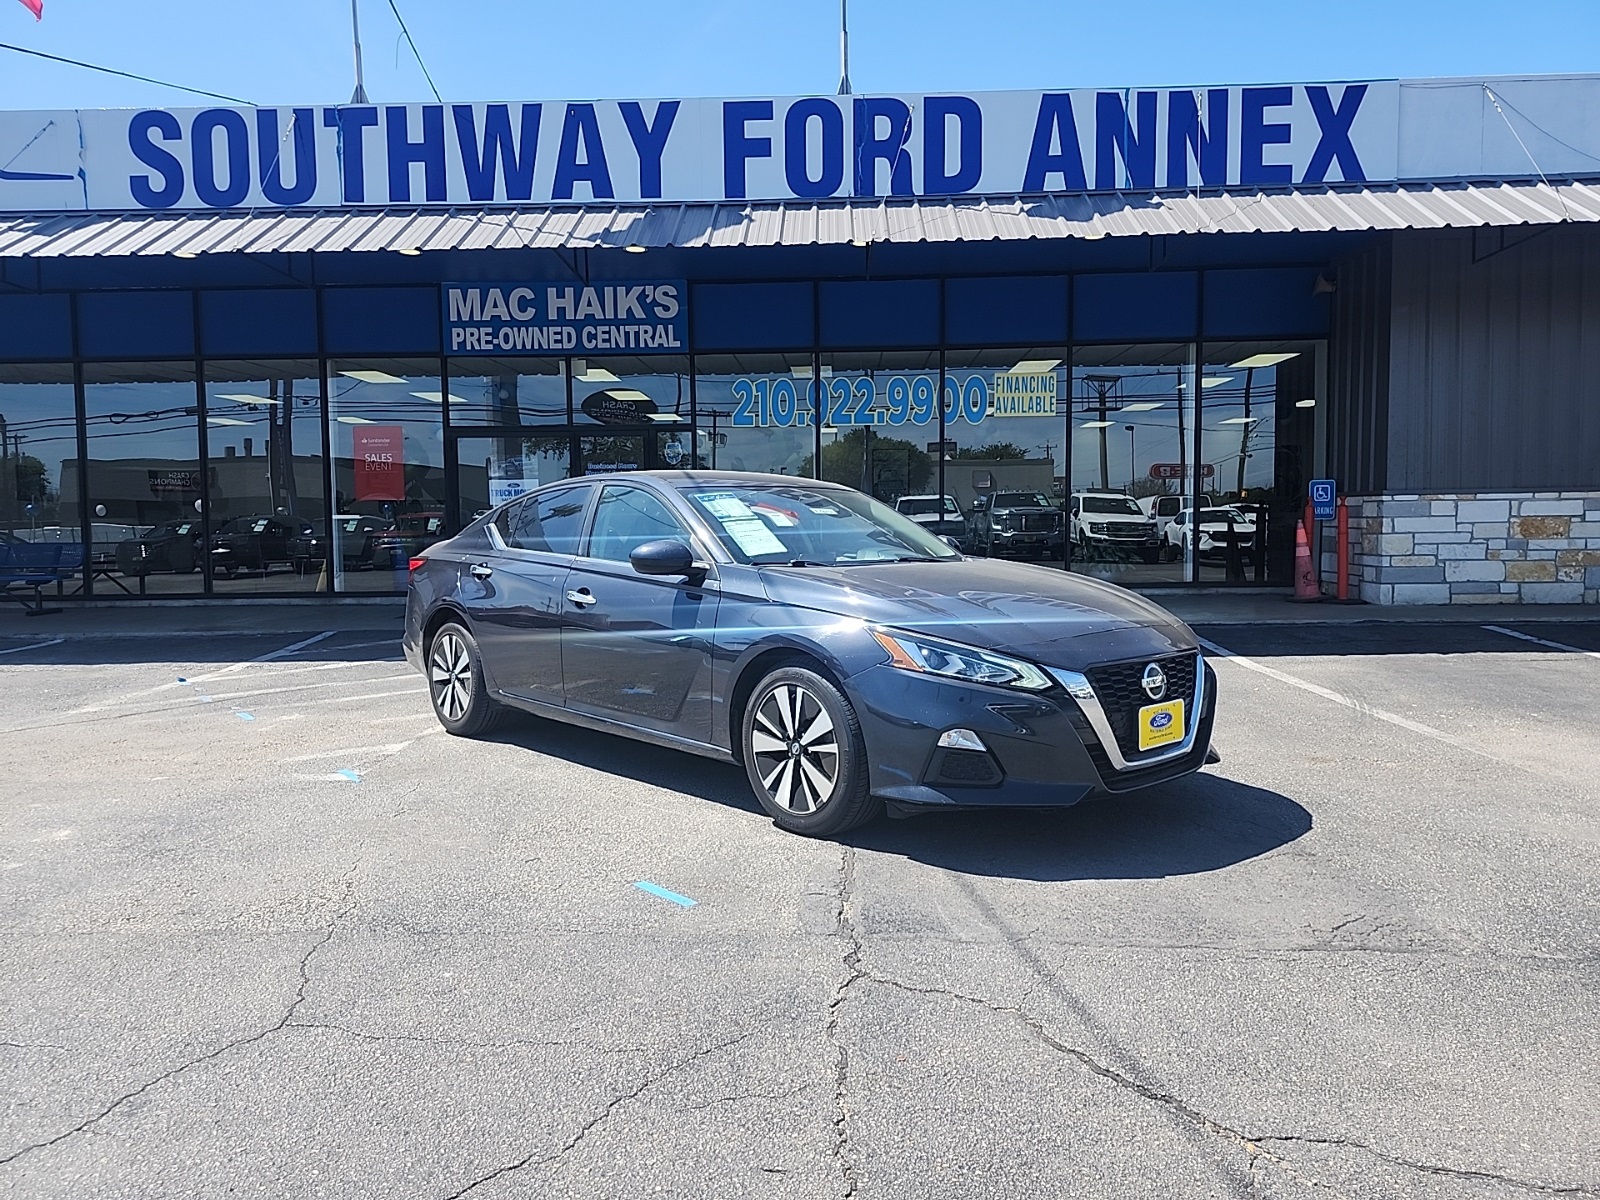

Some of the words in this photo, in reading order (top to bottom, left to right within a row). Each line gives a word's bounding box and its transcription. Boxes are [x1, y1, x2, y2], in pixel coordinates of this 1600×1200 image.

[128, 100, 681, 208] SOUTHWAY
[723, 96, 982, 199] FORD
[1022, 84, 1368, 192] ANNEX
[449, 287, 536, 321] MAC
[547, 285, 679, 320] HAIK'S
[452, 326, 576, 350] PRE-OWNED
[582, 324, 681, 348] CENTRAL
[996, 375, 1055, 394] FINANCING
[731, 375, 989, 428] 210.922.9900
[995, 395, 1055, 413] AVAILABLE
[365, 453, 393, 463] SALES
[365, 462, 392, 471] EVENT
[491, 489, 513, 497] TRUCK
[1314, 506, 1334, 516] ARKING
[1152, 714, 1170, 728] Ford
